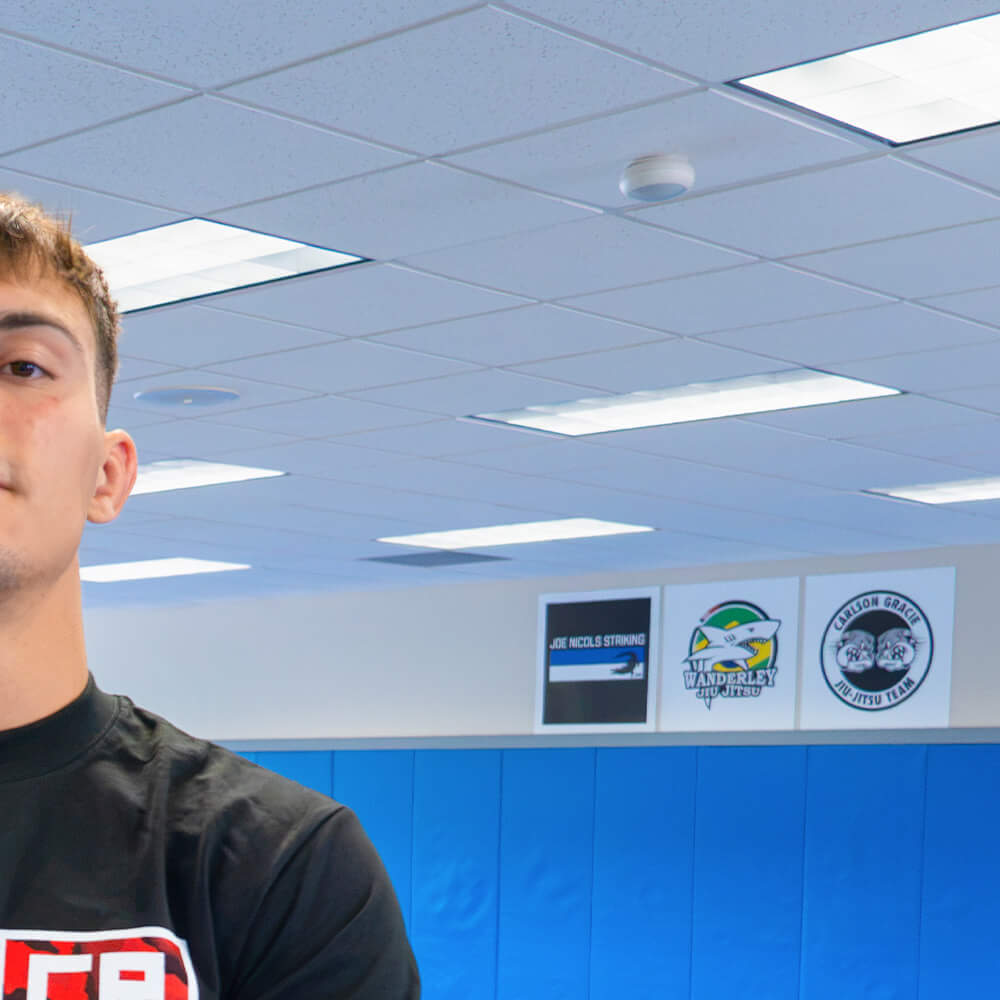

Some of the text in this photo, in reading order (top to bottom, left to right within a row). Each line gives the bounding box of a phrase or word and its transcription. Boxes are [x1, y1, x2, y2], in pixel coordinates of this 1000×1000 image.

[834, 597, 921, 631] CARLSON GRACIE
[549, 633, 645, 650] JOE NICOLS STRIKING
[684, 667, 777, 690] WANDERLEY
[696, 685, 761, 699] JIU JITSU
[835, 677, 915, 705] JIU-JITSU TEAM
